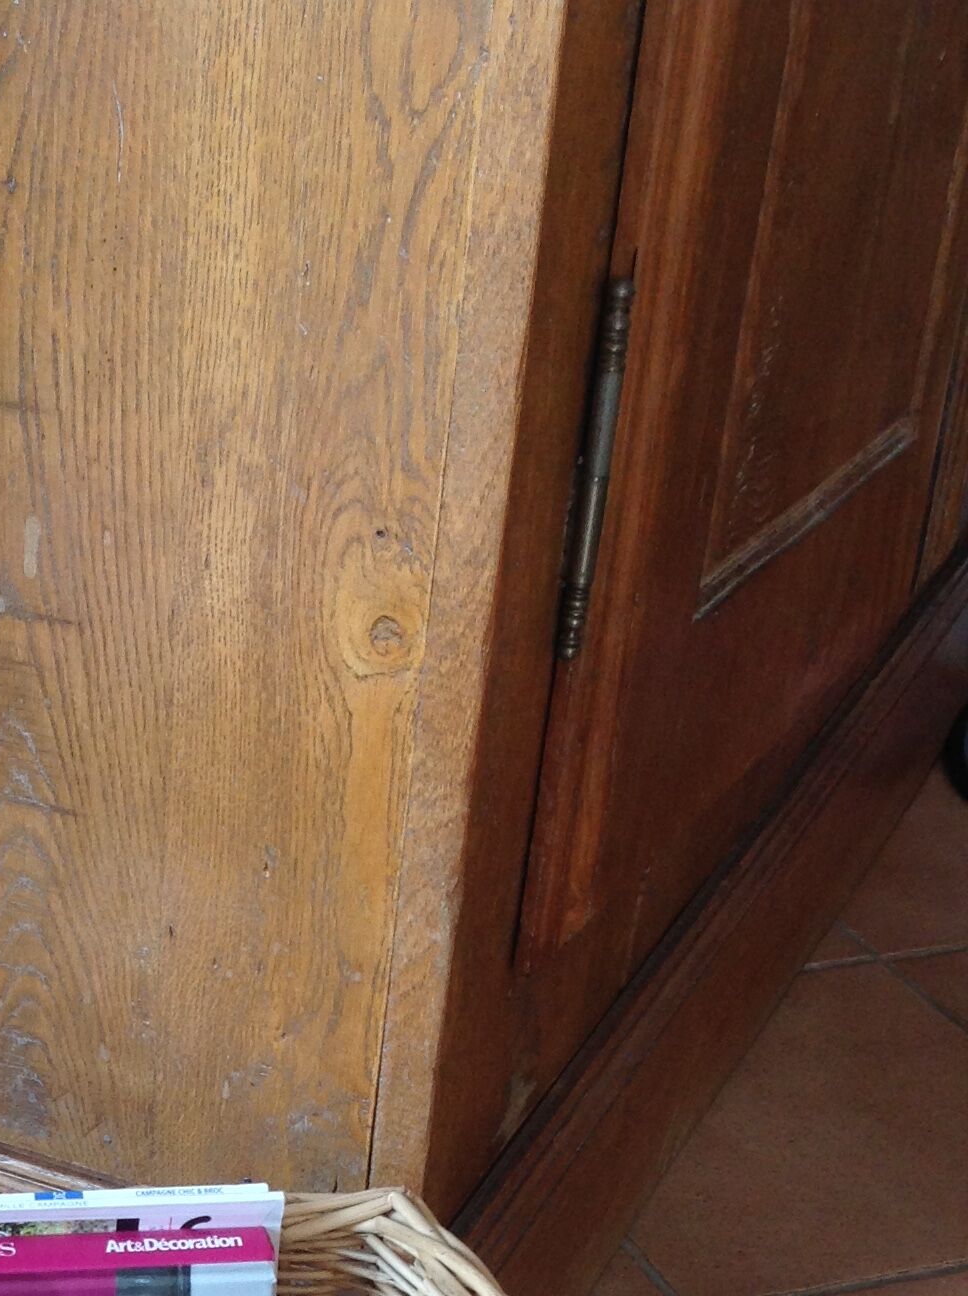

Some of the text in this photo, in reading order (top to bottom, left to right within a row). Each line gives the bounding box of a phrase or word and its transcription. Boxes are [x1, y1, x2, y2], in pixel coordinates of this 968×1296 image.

[135, 1188, 176, 1197] CAMPAGNE
[178, 1188, 195, 1196] CHIC
[104, 1233, 243, 1254] Art&Décoration
